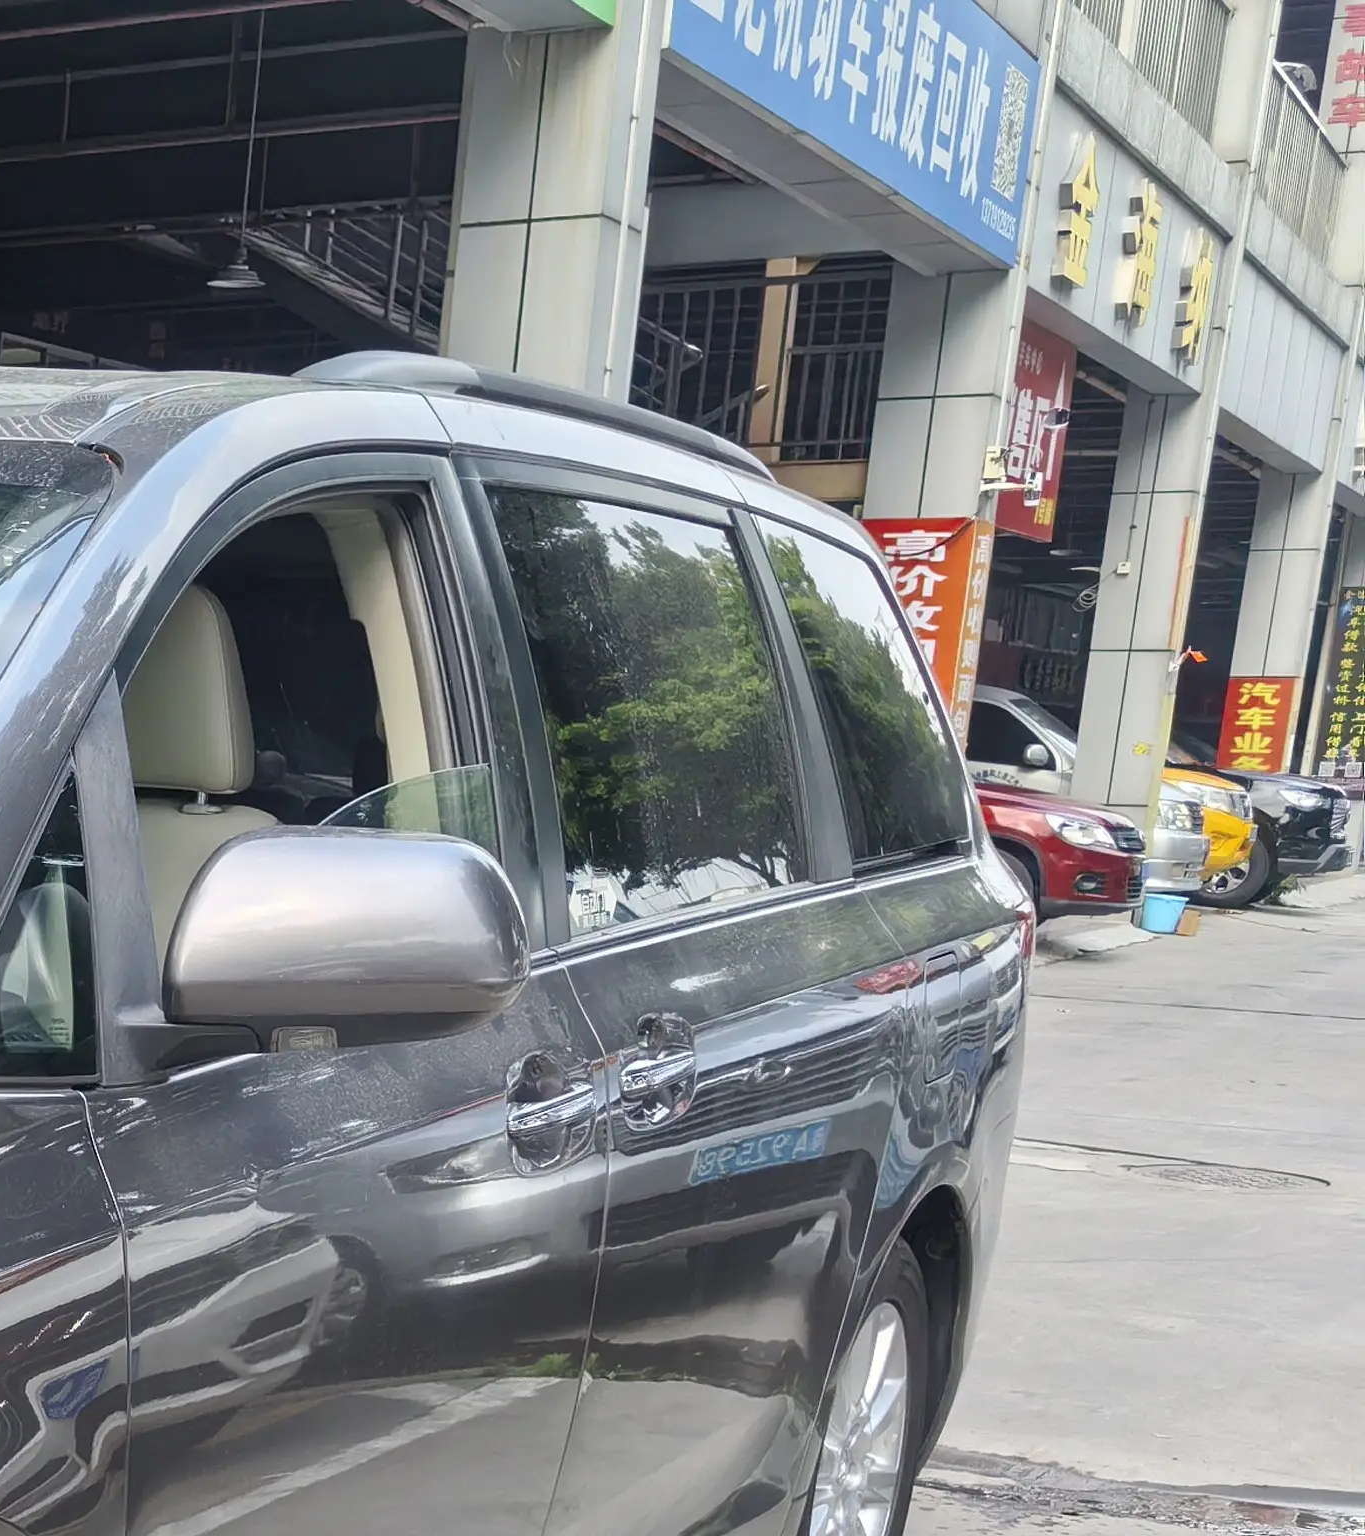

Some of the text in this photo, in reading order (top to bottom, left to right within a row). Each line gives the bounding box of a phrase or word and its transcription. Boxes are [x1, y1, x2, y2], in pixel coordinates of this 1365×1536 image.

[687, 0, 992, 205] 机动车报废回收
